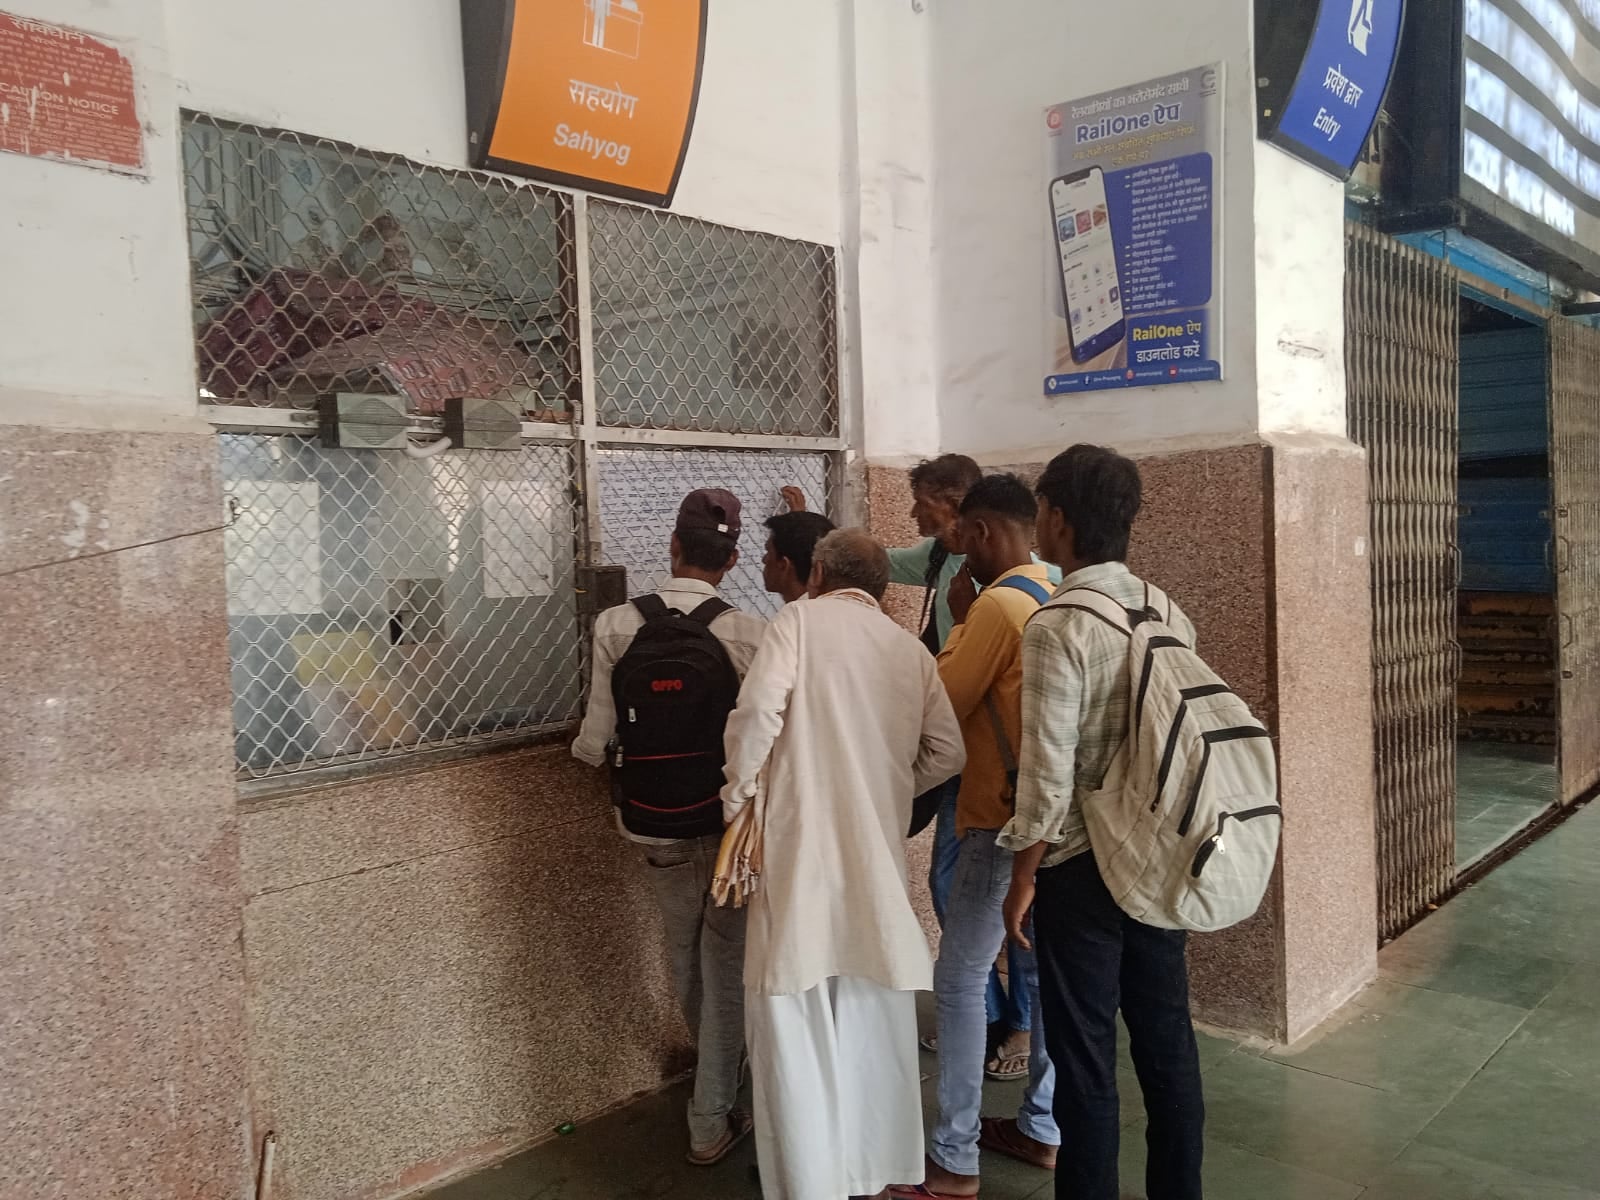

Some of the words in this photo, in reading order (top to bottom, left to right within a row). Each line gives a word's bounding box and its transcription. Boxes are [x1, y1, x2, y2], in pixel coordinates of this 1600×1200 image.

[68, 95, 119, 115] NOTICE
[569, 79, 640, 119] सहयोग
[1323, 63, 1349, 98] प्रवेश
[1343, 81, 1364, 109] द्वार
[1077, 113, 1150, 143] RailOne
[1153, 103, 1181, 124] ऐप
[1313, 106, 1341, 142] Entry
[554, 123, 632, 166] Sahyog
[1133, 324, 1183, 342] RailOne
[1187, 319, 1202, 336] ऐप
[1136, 342, 1181, 363] डाउनलोड
[1182, 340, 1201, 358] करें
